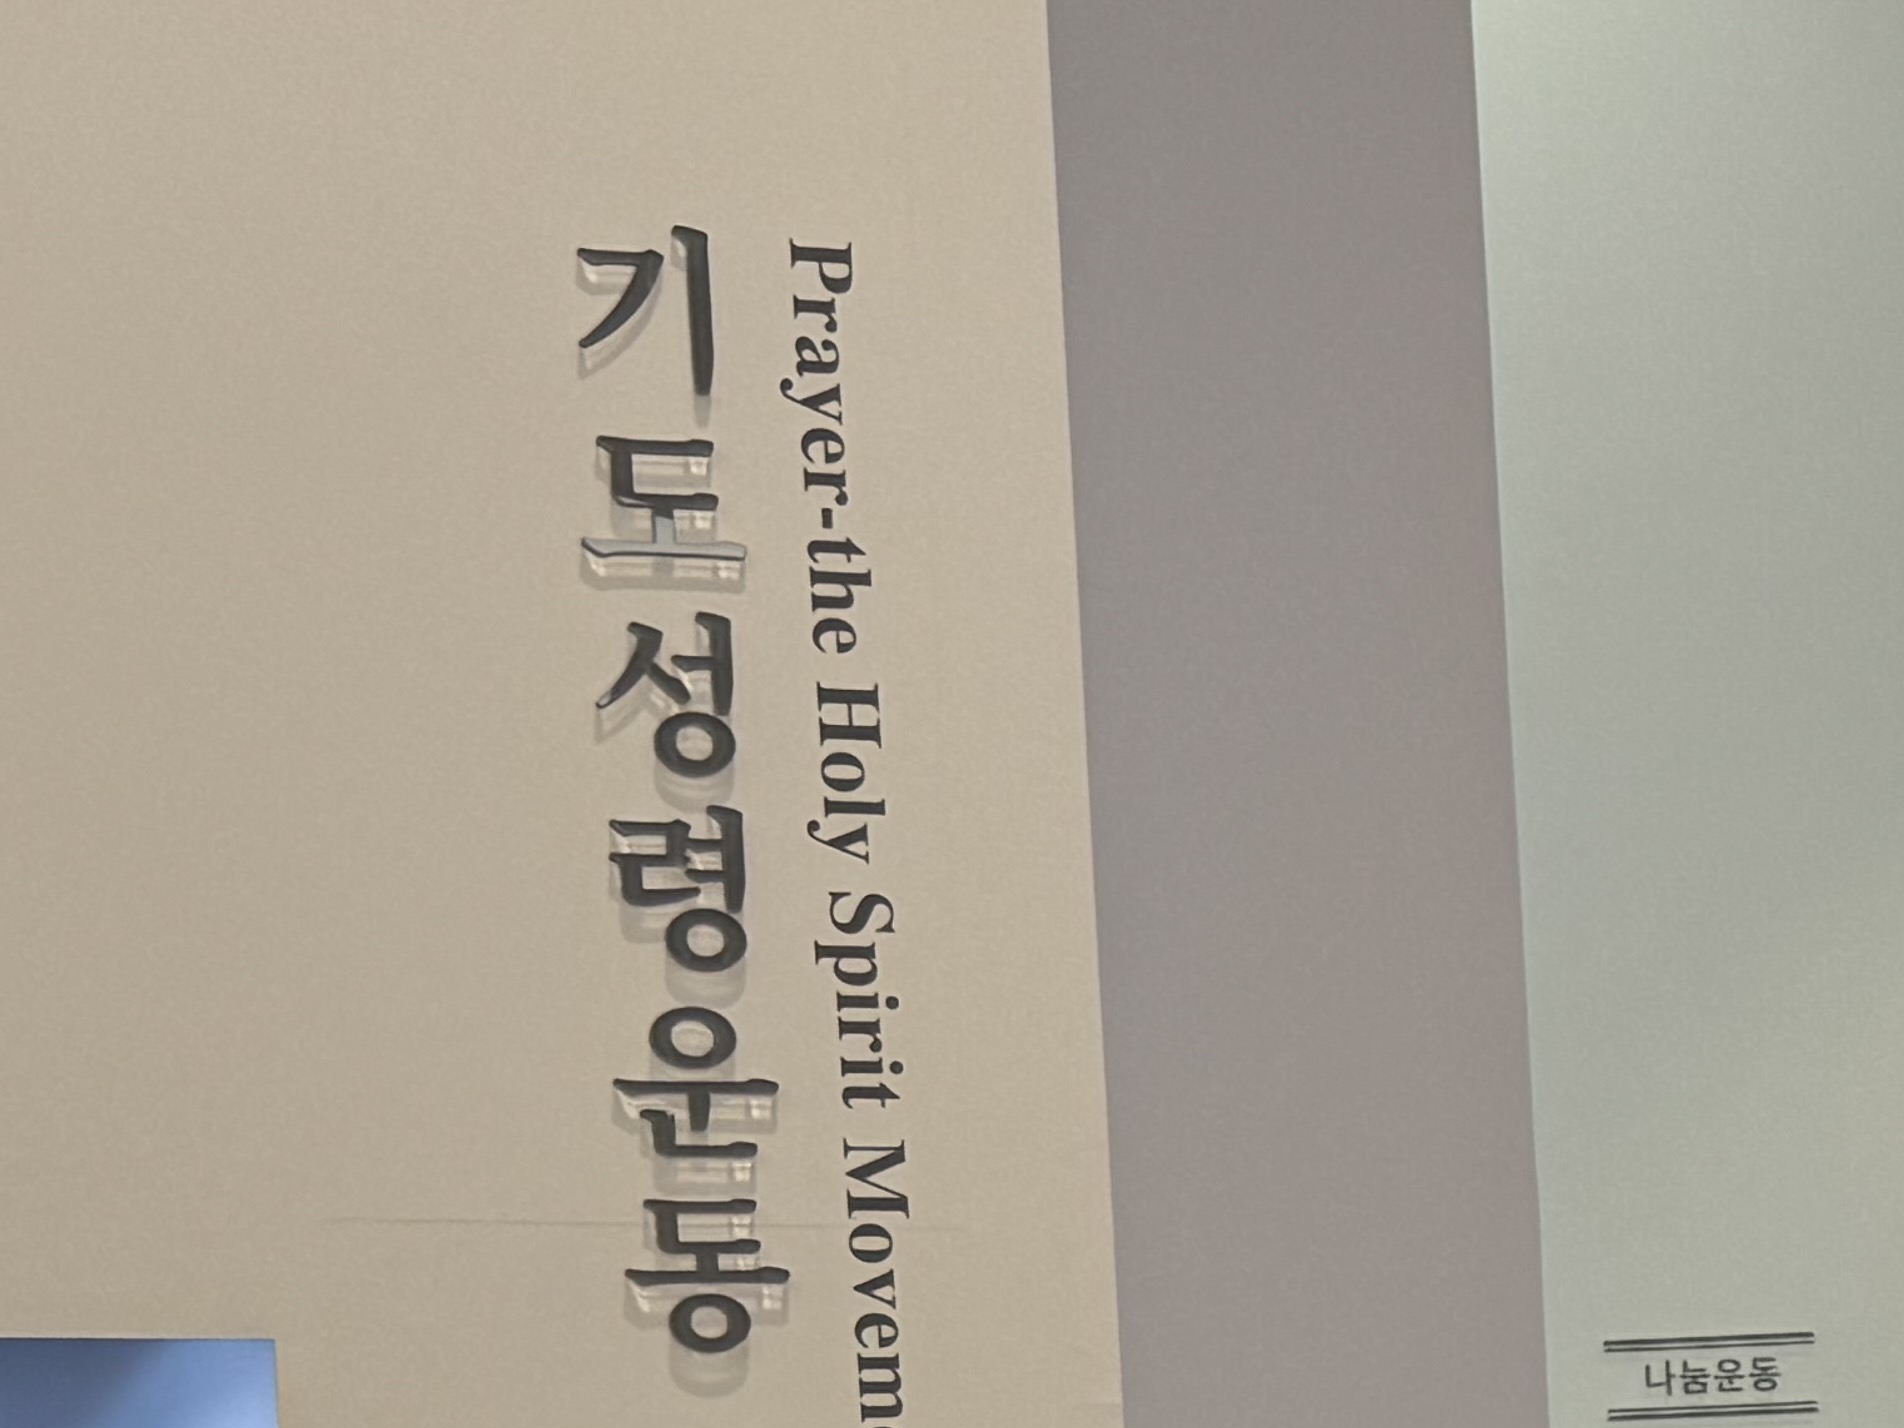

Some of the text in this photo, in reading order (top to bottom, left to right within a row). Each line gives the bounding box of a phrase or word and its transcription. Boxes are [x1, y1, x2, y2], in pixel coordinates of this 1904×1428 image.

[780, 240, 873, 654] Prayer-the
[576, 226, 792, 1354] 기도성령운동
[807, 682, 886, 864] Holy
[813, 890, 904, 1110] Spirit
[1645, 1356, 1781, 1397] 나눔운동
